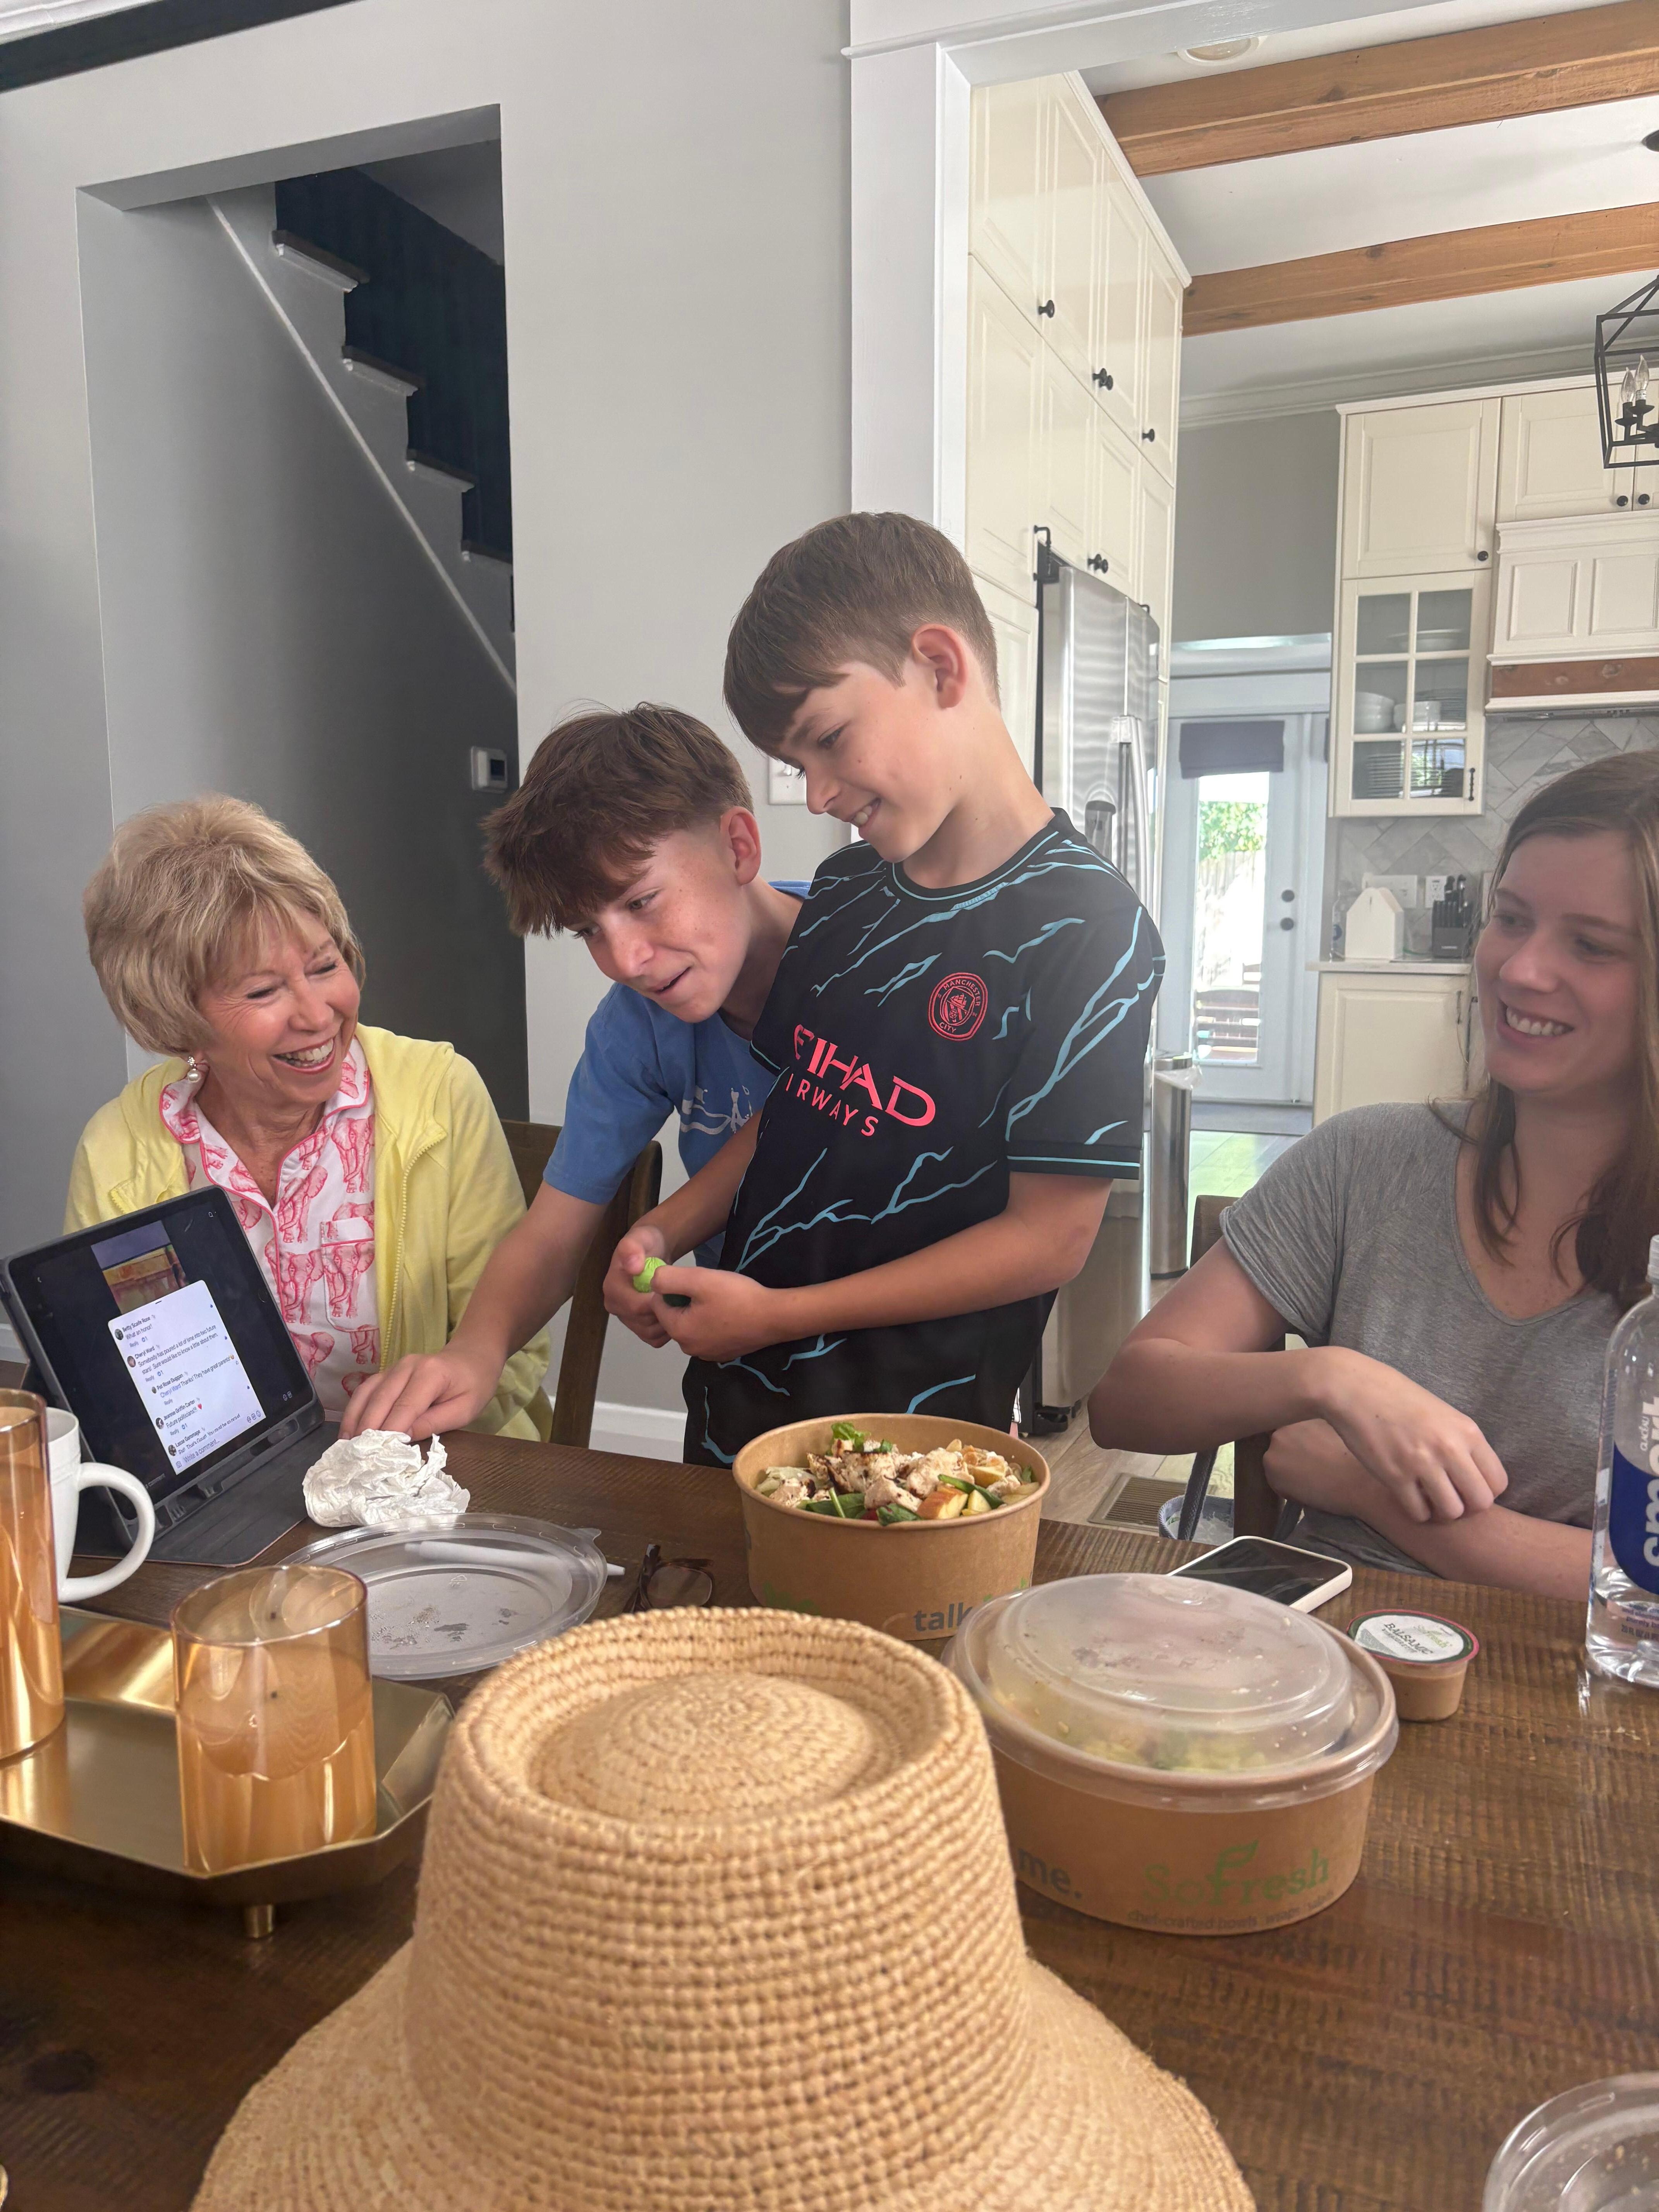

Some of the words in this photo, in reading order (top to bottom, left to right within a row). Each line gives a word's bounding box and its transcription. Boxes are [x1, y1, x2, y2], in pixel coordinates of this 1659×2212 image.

[944, 979, 981, 1006] MANCHESTER
[939, 1022, 957, 1033] CITY
[140, 1323, 153, 1333] honor!
[134, 1350, 146, 1359] Cheryl
[137, 1354, 157, 1367] Somebody
[163, 1344, 176, 1355] poured
[142, 1365, 152, 1374] stars!
[161, 1355, 172, 1364] would
[199, 1336, 210, 1344] about
[160, 1388, 172, 1398] Cheryl
[171, 1382, 181, 1391] Ward
[180, 1376, 194, 1386] Thanks!
[210, 1363, 218, 1372] great
[170, 1374, 183, 1383] Duggan
[175, 1405, 186, 1413] Griffin
[184, 1399, 195, 1407] Carter
[166, 1419, 178, 1428] Future
[183, 1453, 196, 1463] Write
[914, 1602, 973, 1632] talk
[1017, 1848, 1083, 1899] me.
